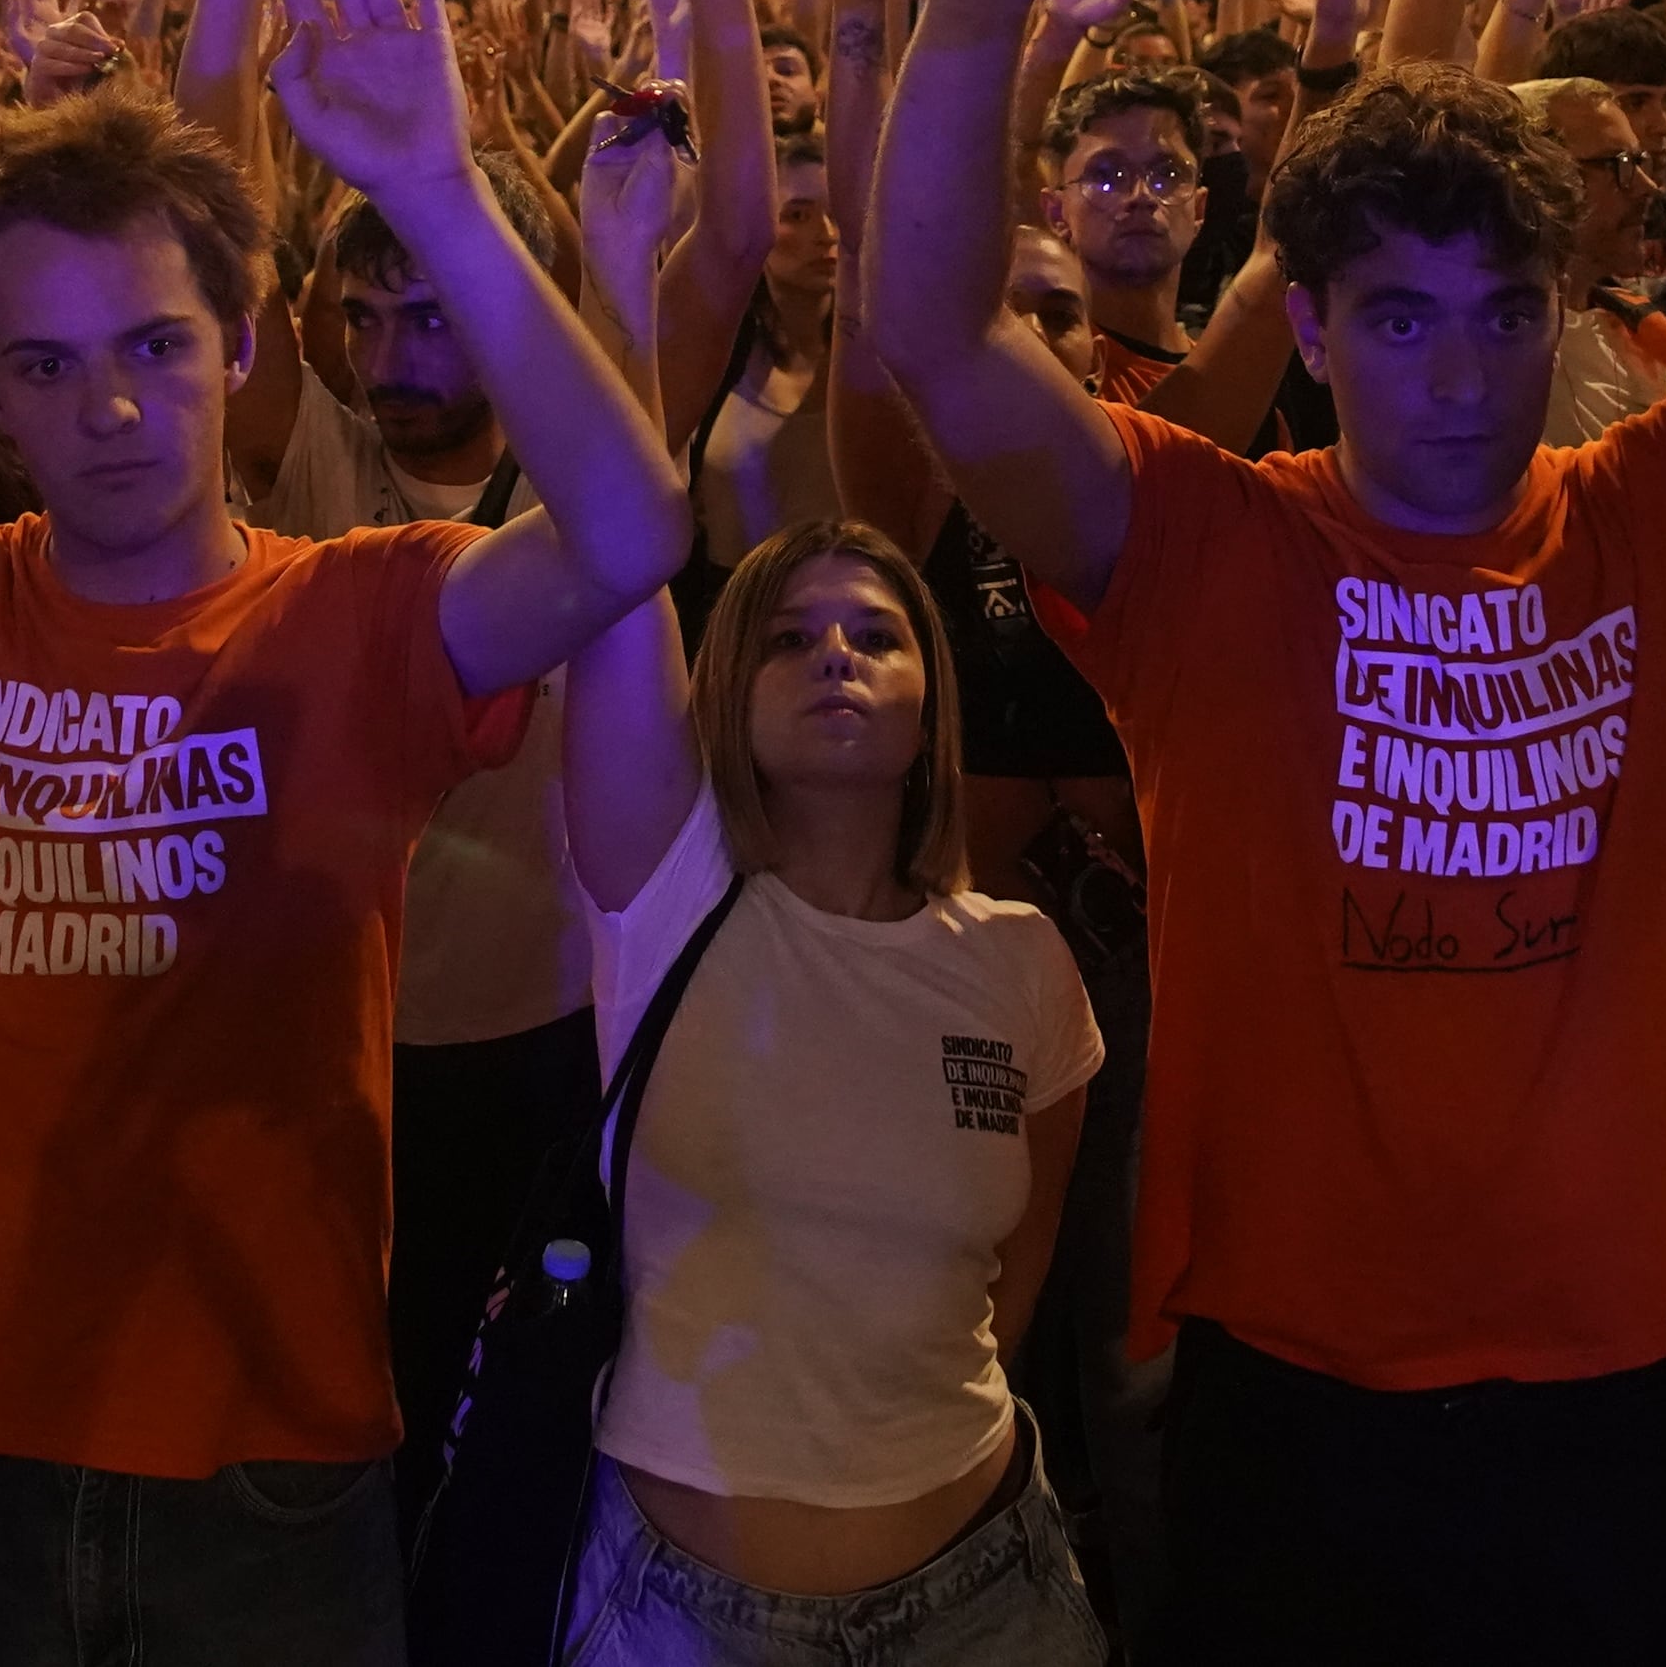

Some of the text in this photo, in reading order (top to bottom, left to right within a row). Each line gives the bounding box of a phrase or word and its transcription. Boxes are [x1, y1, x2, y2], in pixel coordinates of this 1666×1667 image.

[1337, 714, 1629, 816] E INQUILINOS
[1332, 799, 1600, 878] DE MADRID
[1341, 886, 1578, 964] Nodo Sur
[941, 1035, 1013, 1064] SINDICATO
[945, 1060, 967, 1082] DE
[951, 1086, 961, 1106] E
[955, 1109, 975, 1130] DE
